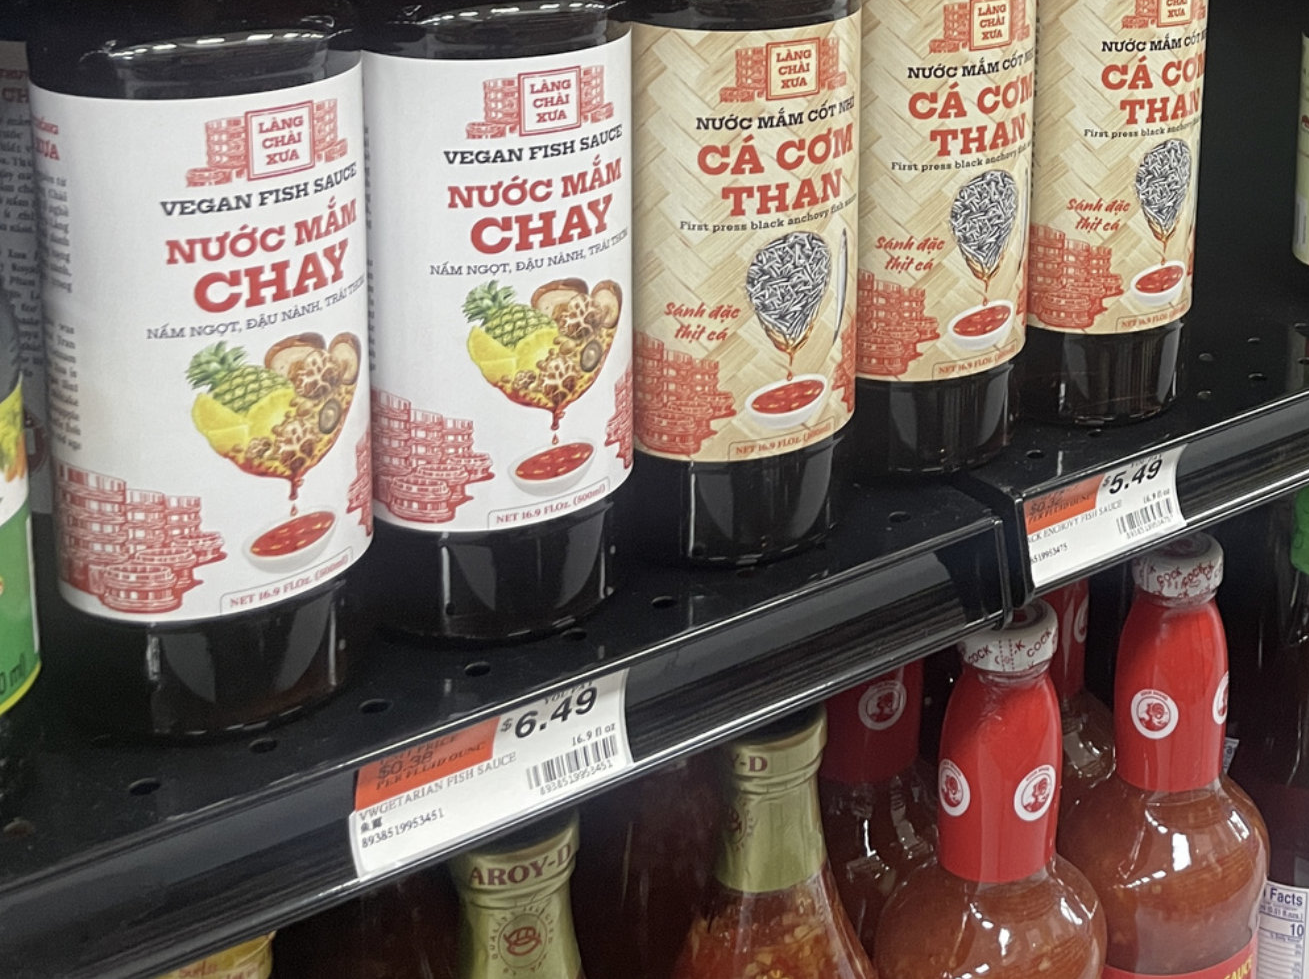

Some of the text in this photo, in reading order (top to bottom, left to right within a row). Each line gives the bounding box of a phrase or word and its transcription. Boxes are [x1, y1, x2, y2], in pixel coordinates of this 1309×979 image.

[978, 4, 1006, 16] LÀNG
[980, 17, 1005, 29] CHÀI
[982, 30, 1003, 41] XƯA
[1101, 33, 1182, 52] NƯỚC MẮM
[776, 49, 812, 63] LÀNG
[778, 63, 810, 76] CHÀI
[907, 57, 999, 79] NƯỚC MẮM
[1101, 55, 1153, 90] CÁ
[530, 78, 571, 94] LÀNG
[781, 77, 808, 89] XƯA
[533, 94, 569, 109] CHÀI
[908, 72, 1033, 119] CÁ CƠM
[1120, 87, 1200, 125] THAN
[258, 115, 304, 134] LÀNG
[536, 110, 567, 123] XƯA
[696, 108, 804, 130] NƯỚC MẮM
[262, 131, 302, 150] CHÀI
[930, 112, 1026, 157] THAN
[1084, 127, 1165, 139] First press black
[444, 124, 622, 165] VEGAN FISH SAUCE
[697, 122, 853, 175] CÁ CƠM
[891, 158, 983, 173] First press black
[160, 162, 357, 217] VEGAN FISH SAUCE
[448, 154, 622, 208] NƯỚC MẮM
[721, 168, 843, 217] THAN
[1066, 197, 1103, 212] Sánh
[166, 195, 357, 265] NƯỚC MẮM
[470, 194, 613, 254] CHAY
[680, 209, 830, 233] First press black anchovy
[1103, 219, 1120, 231] cá
[875, 236, 945, 255] Sánh đặc
[430, 258, 544, 276] NẤM NGỌT, ĐẬU
[916, 259, 934, 271] cá
[193, 239, 349, 313] CHAY
[664, 301, 741, 324] Sánh đặc
[707, 327, 728, 342] cá
[736, 445, 755, 455] NET
[1102, 459, 1163, 495] $5.49
[496, 508, 541, 524] NET 16.9
[230, 586, 281, 608] NET 16.9
[1026, 627, 1052, 659] COCK
[500, 685, 598, 740] $6.49
[571, 729, 593, 747] 16.9
[604, 722, 616, 734] oz
[446, 769, 474, 788] FISH
[477, 751, 517, 776] SAUCE
[1270, 887, 1303, 907] Facts
[1290, 923, 1304, 937] 10
